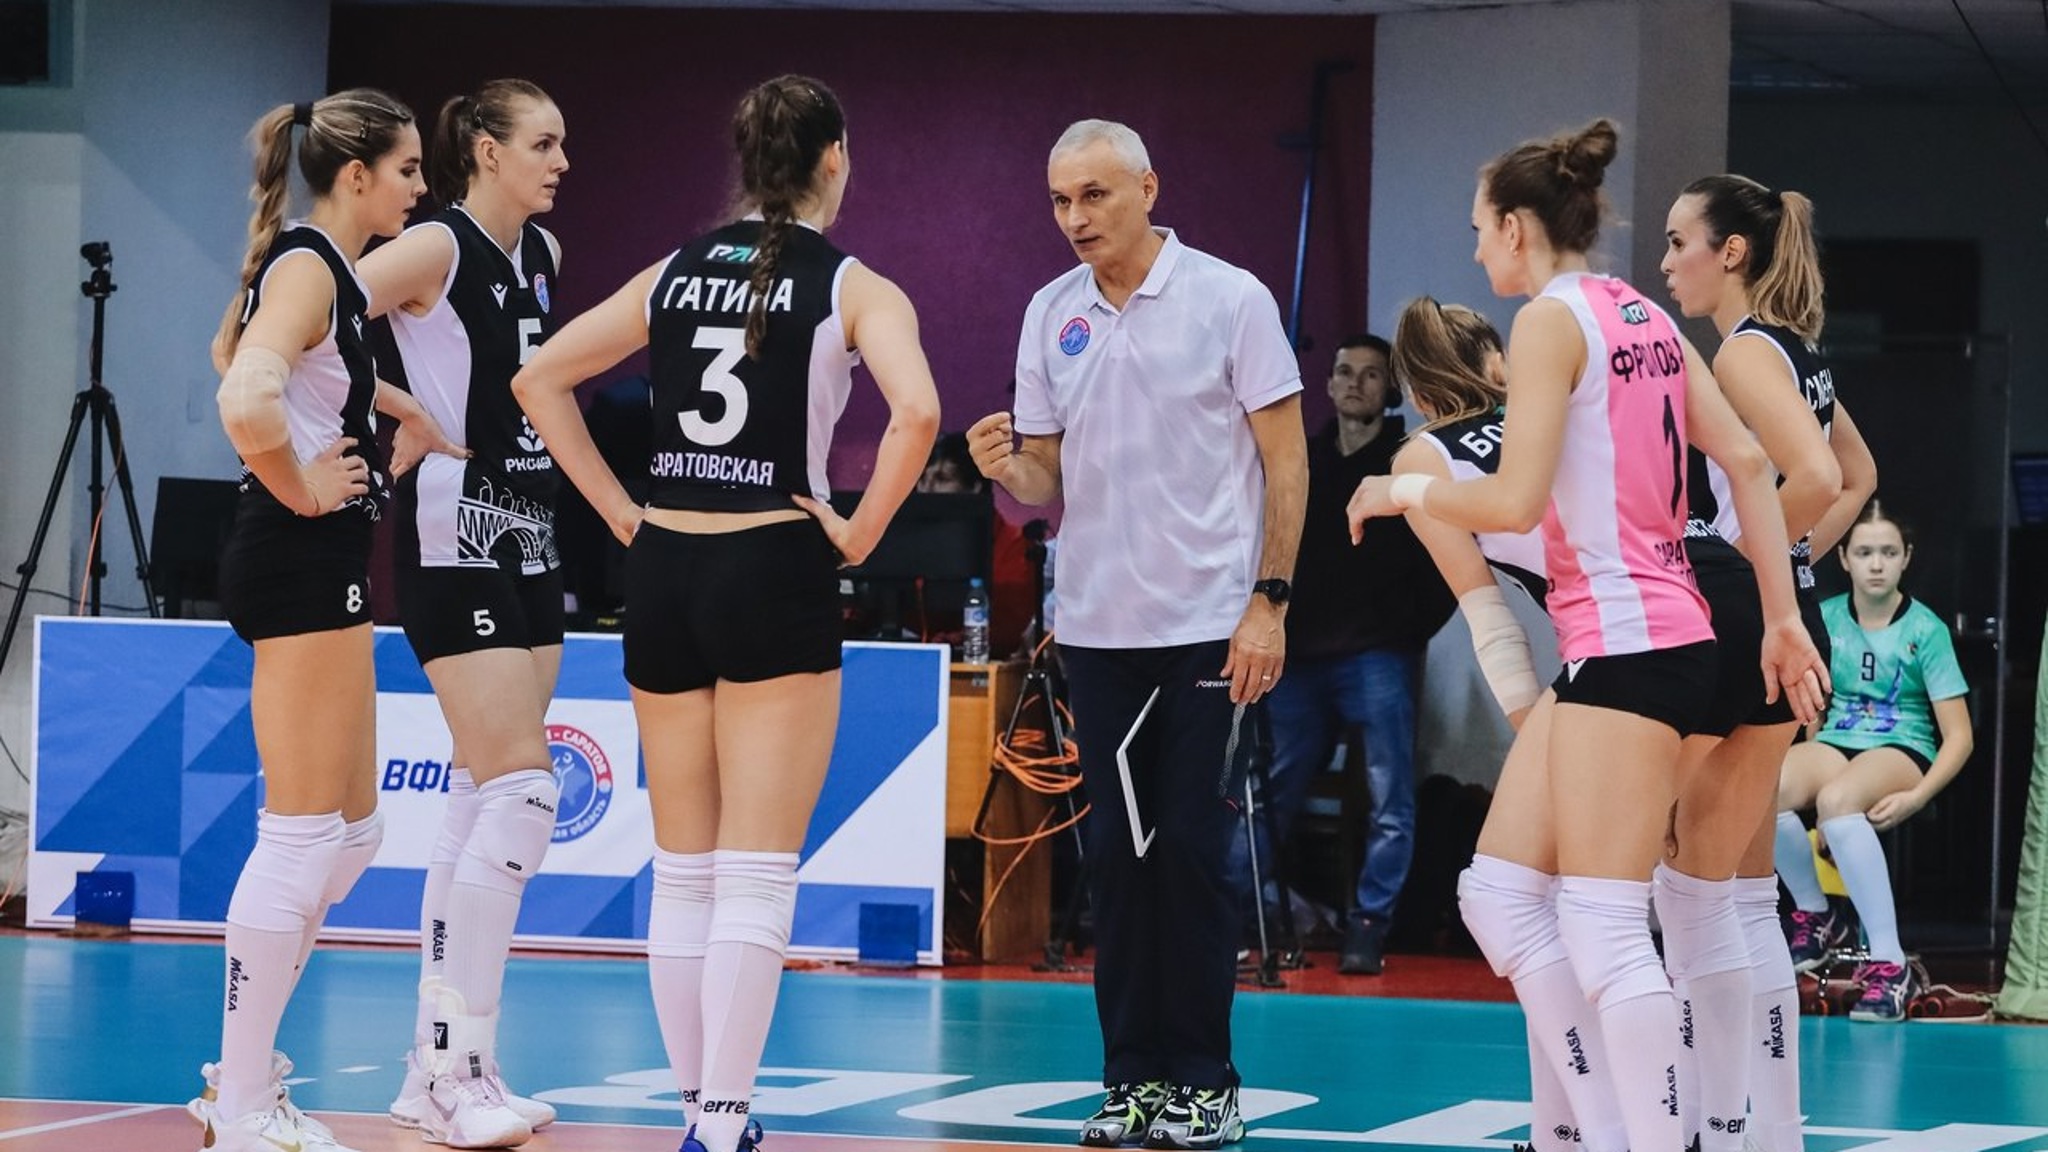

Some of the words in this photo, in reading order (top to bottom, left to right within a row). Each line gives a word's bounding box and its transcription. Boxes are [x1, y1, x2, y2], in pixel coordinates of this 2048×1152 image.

[677, 326, 750, 446] 3
[1459, 421, 1505, 458] БО
[1662, 394, 1683, 519] 1
[347, 584, 362, 613] 8
[473, 609, 495, 636] 5
[1861, 652, 1875, 681] 9
[562, 729, 608, 775] САРАТОВ
[381, 759, 452, 792] ВФ
[433, 919, 448, 962] MIKASA
[228, 956, 250, 1012] MIKASA
[1566, 1026, 1590, 1075] MIKASA
[1762, 1004, 1785, 1059] MIKASA
[1662, 1064, 1679, 1116] MIKASA
